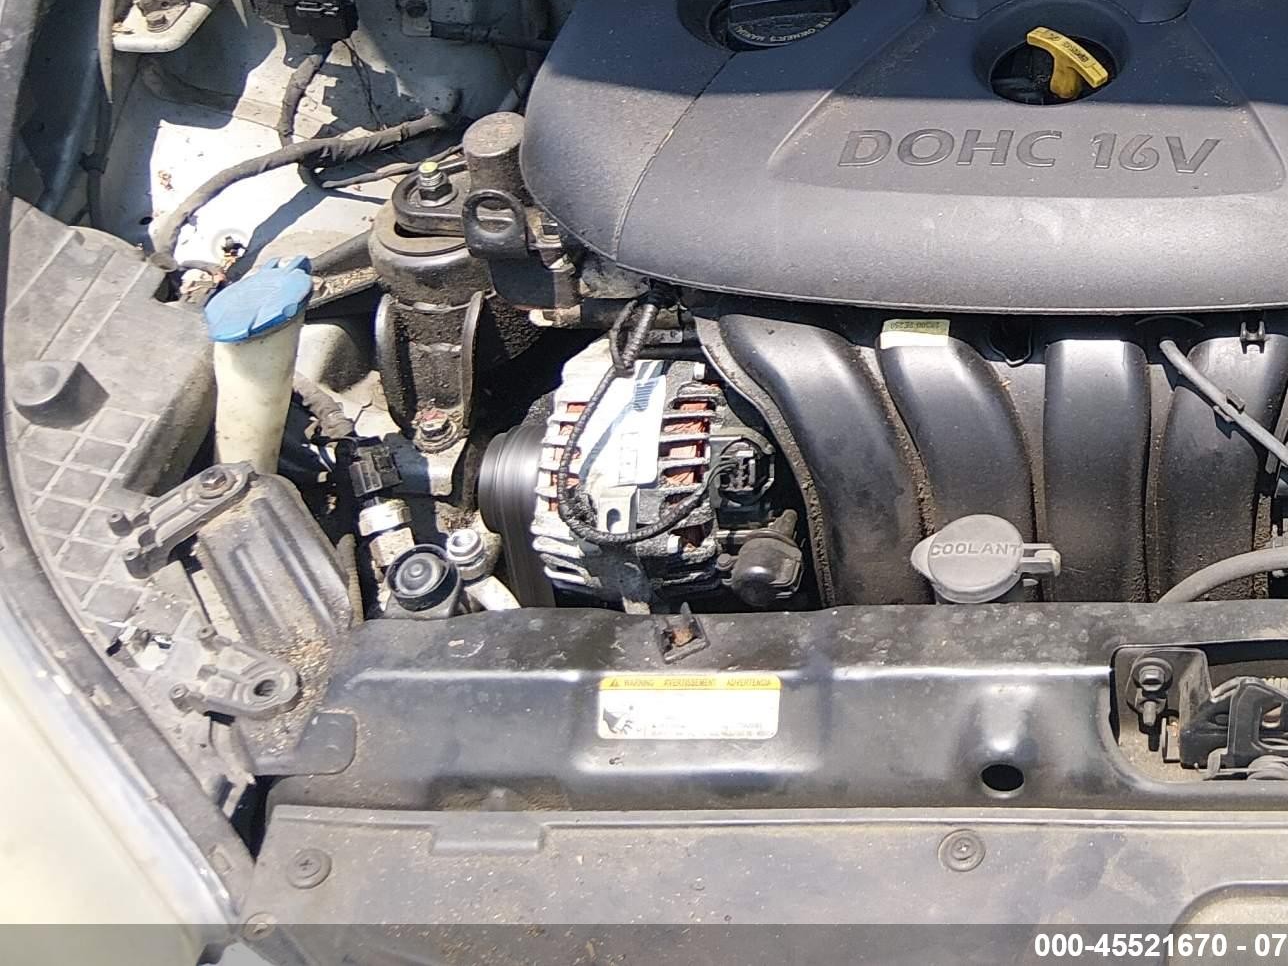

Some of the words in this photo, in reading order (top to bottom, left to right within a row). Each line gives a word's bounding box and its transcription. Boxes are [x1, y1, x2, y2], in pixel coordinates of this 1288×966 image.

[734, 25, 766, 42] MANUAL
[837, 128, 1063, 169] DOHC
[1090, 131, 1221, 175] 16V
[929, 542, 1021, 557] COOLANT
[622, 678, 655, 688] WARNING
